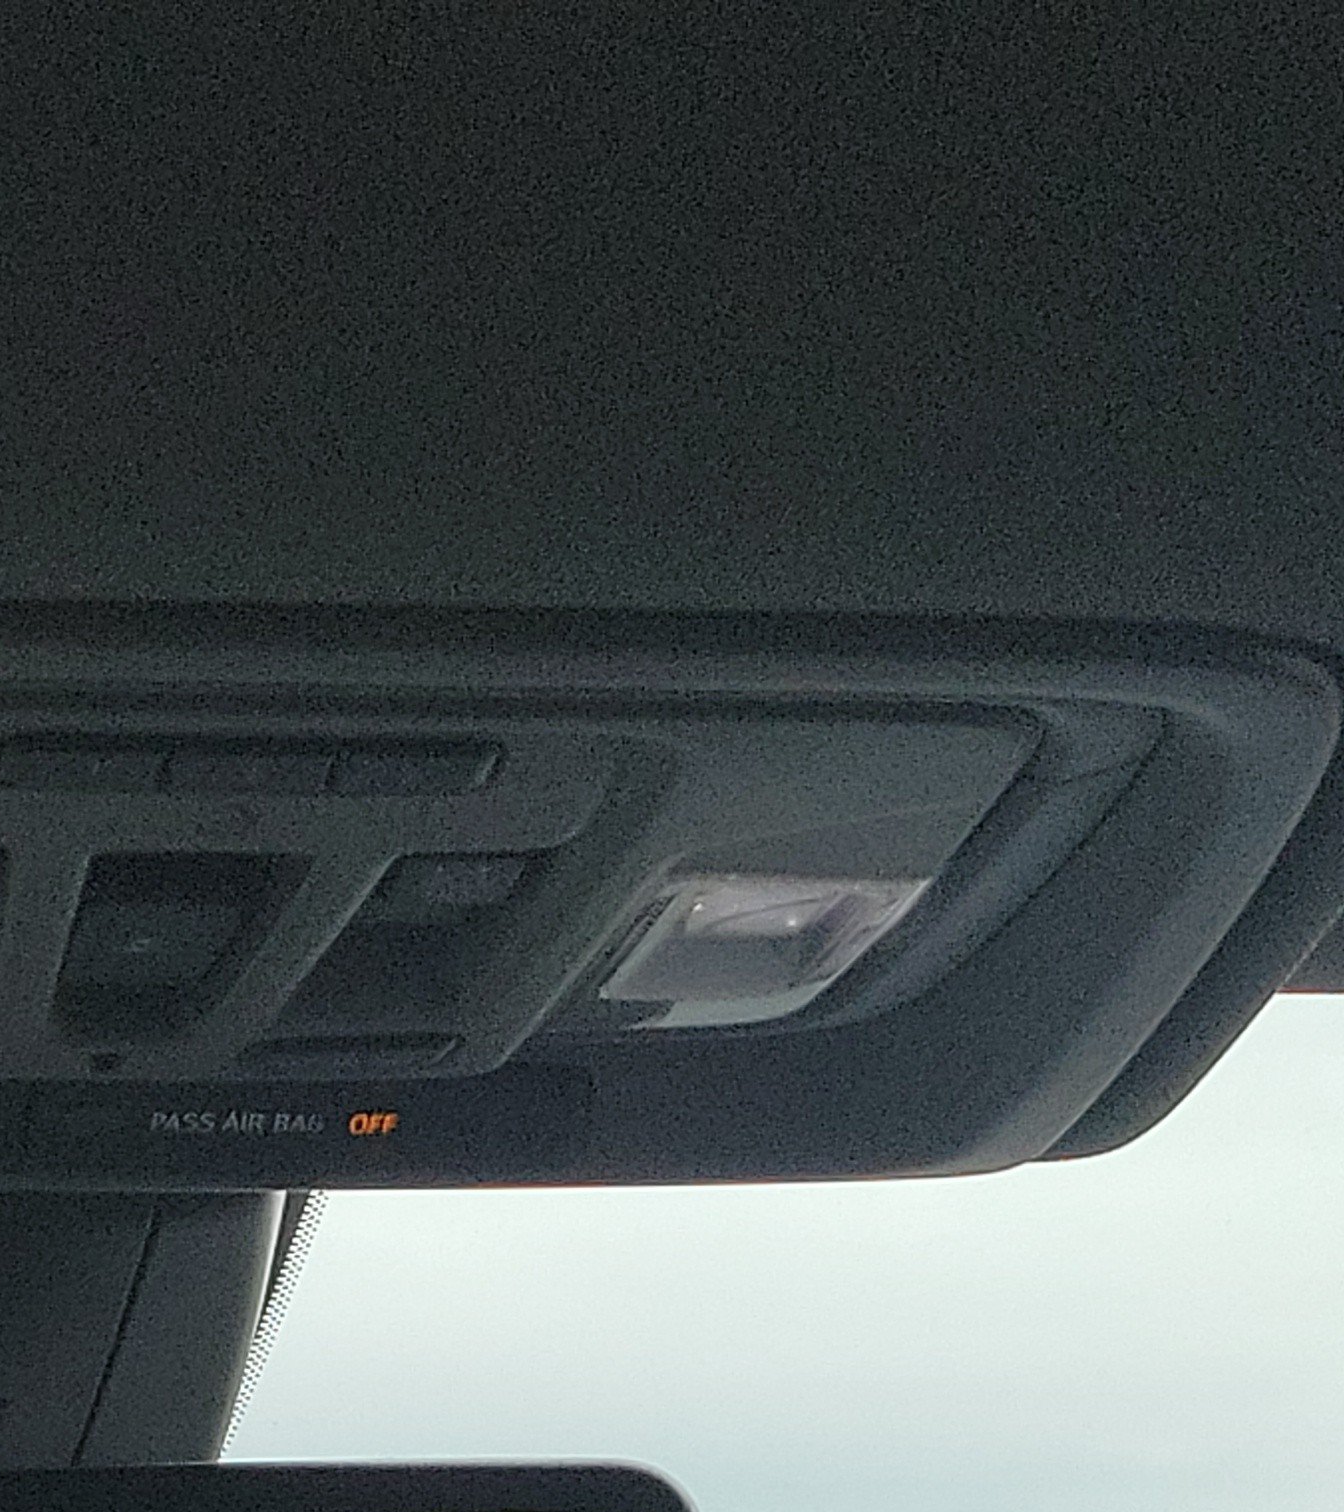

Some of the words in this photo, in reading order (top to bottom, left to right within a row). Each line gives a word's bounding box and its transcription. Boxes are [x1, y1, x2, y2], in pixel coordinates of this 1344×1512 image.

[149, 1111, 215, 1133] PASS
[222, 1110, 263, 1133] AIR
[272, 1112, 325, 1133] BAG
[348, 1112, 399, 1135] OFF
